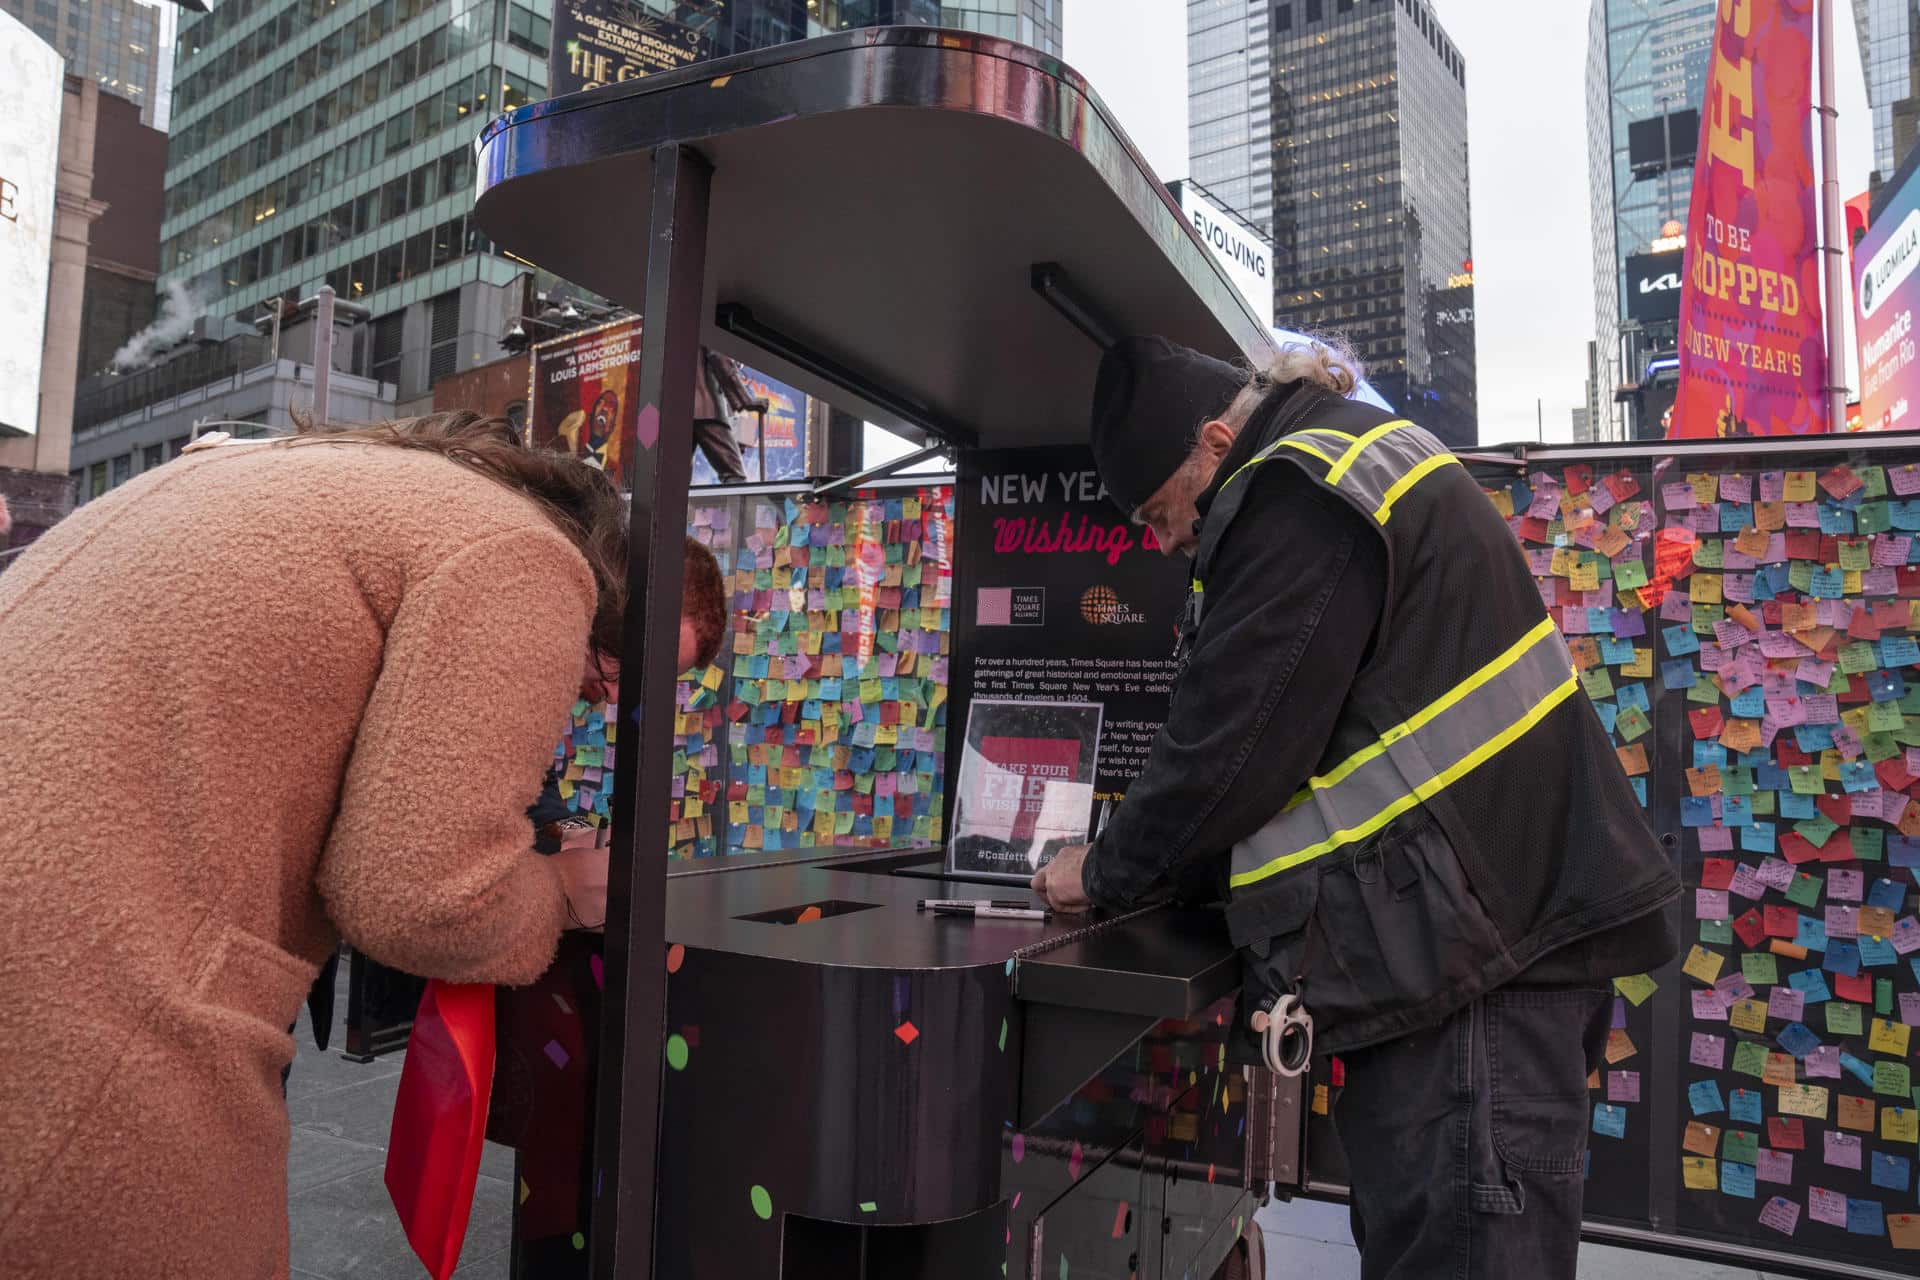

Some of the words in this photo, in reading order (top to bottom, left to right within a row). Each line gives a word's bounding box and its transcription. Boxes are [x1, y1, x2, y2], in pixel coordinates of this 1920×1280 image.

[597, 31, 677, 65] EXTRAVAGANZA
[621, 28, 640, 41] BIG
[641, 35, 697, 62] BROADWAY
[570, 48, 613, 82] THE
[1706, 213, 1724, 244] TO
[1727, 224, 1752, 252] BE
[1193, 210, 1266, 278] EVOLVING
[1876, 229, 1917, 288] LUDMILLA
[1863, 309, 1912, 371] Numanice
[577, 340, 632, 363] KNOCKOUT
[1692, 331, 1731, 363] NEW
[1736, 341, 1802, 377] YEAR'S
[1900, 338, 1915, 369] Rio
[550, 367, 578, 384] LOUIS
[578, 350, 641, 376] ARMSTRONG!
[981, 473, 1049, 505] NEW
[993, 512, 1133, 565] Wishing
[1016, 595, 1039, 603] TIMES
[1013, 603, 1041, 612] SQUARE
[1097, 603, 1129, 613] TIMES
[1014, 611, 1039, 619] ALLIANCE
[1101, 613, 1145, 625] SQUARE
[975, 657, 987, 666] For
[1012, 657, 1044, 667] hundred
[1071, 658, 1094, 668] Times
[1095, 659, 1125, 669] Square
[1125, 660, 1141, 668] has
[1142, 659, 1164, 669] been
[1165, 659, 1179, 669] the
[974, 669, 1014, 679] gatherings
[1015, 670, 1024, 678] of
[1024, 671, 1045, 680] great
[1046, 670, 1083, 679] historical
[1083, 671, 1100, 680] and
[1101, 671, 1141, 680] emotional
[974, 681, 987, 689] the
[991, 681, 1007, 689] first
[1012, 681, 1035, 690] Times
[1040, 681, 1068, 691] Square
[1073, 681, 1091, 691] New
[1096, 682, 1120, 692] Year's
[1125, 683, 1140, 692] Eve
[974, 692, 1014, 701] thousands
[1014, 693, 1023, 701] of
[1024, 694, 1056, 703] revelers
[1057, 694, 1065, 702] in
[1104, 719, 1115, 729] by
[1116, 719, 1144, 731] writing
[1110, 731, 1129, 740] New
[1121, 743, 1133, 753] for
[1108, 756, 1127, 766] wish
[1128, 757, 1140, 766] on
[1031, 763, 1070, 777] YOUR
[1098, 767, 1123, 778] Year's
[1124, 768, 1140, 778] Eve
